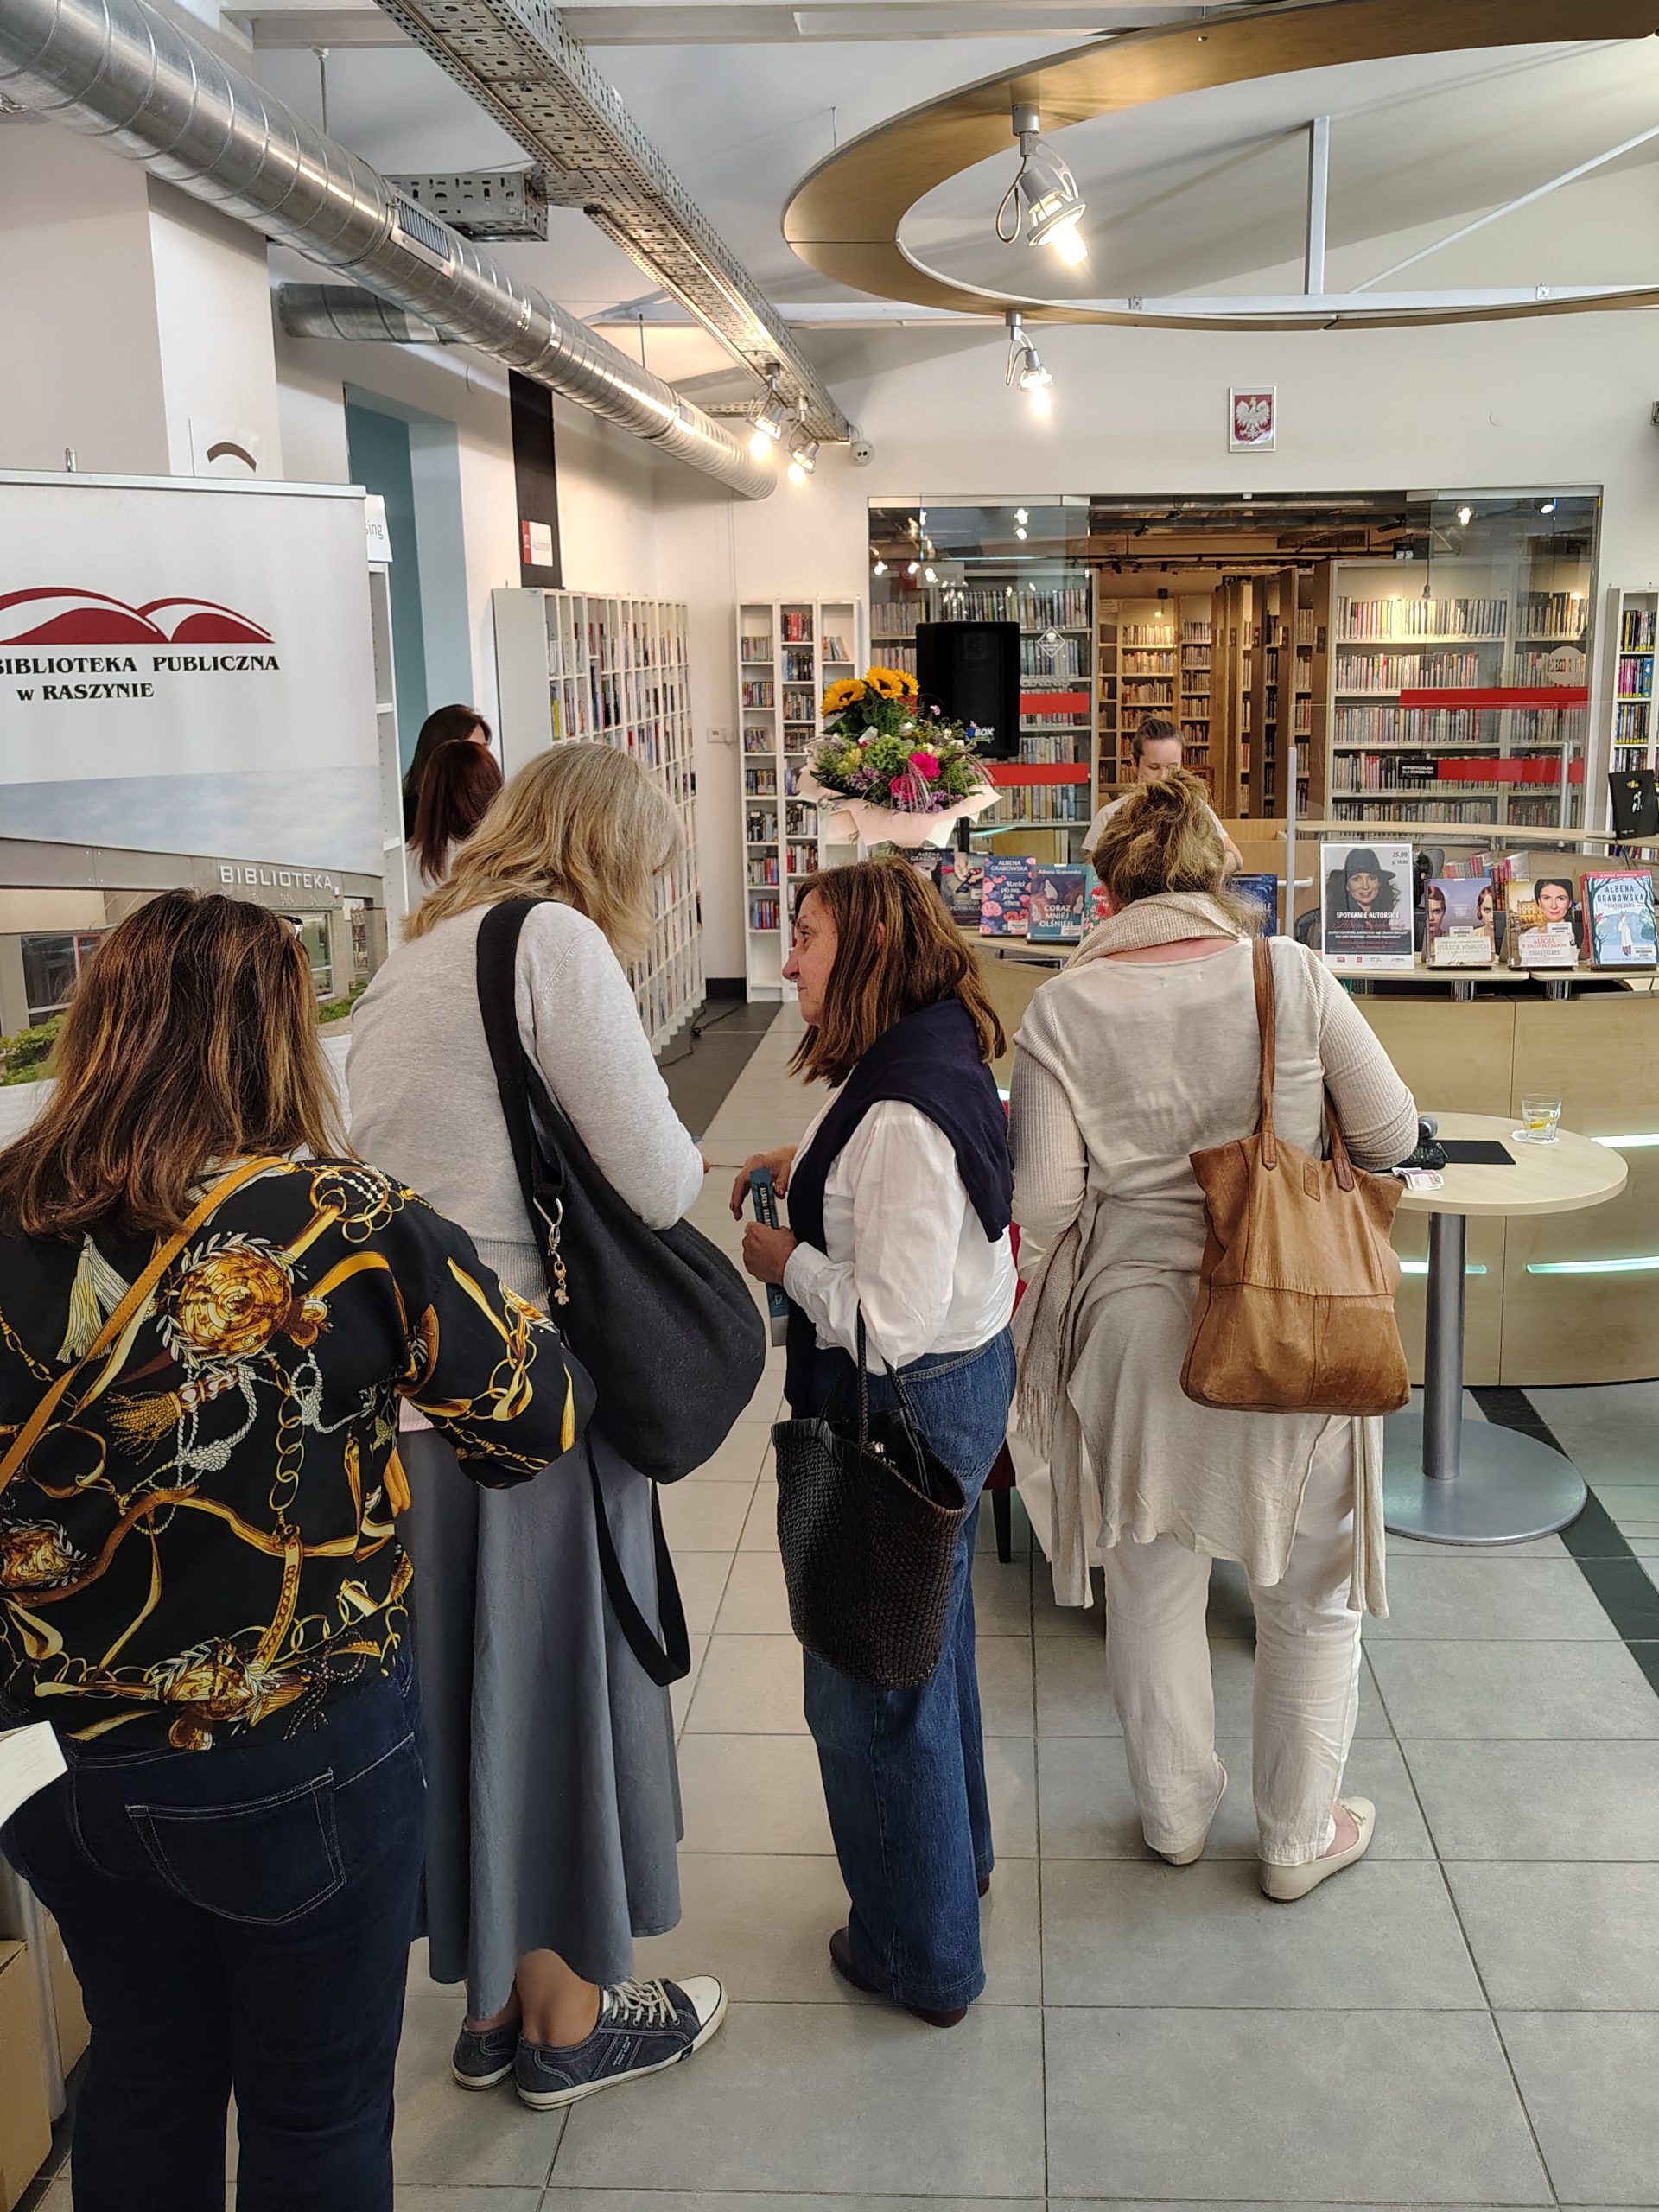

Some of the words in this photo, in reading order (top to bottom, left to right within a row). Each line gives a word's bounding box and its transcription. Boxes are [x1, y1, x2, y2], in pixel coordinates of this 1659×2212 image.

[0, 657, 137, 675] IBLIOTEKA
[152, 655, 281, 672] PUBLICZNA
[16, 689, 35, 701] w
[42, 683, 155, 701] RASZYNIE
[220, 865, 333, 890] BIBLIOTEKA
[1605, 884, 1635, 893] AŁBENA
[1597, 893, 1644, 903] GRABOWSKA
[1044, 904, 1071, 912] CORAZ
[1045, 912, 1070, 920] MNIEJ
